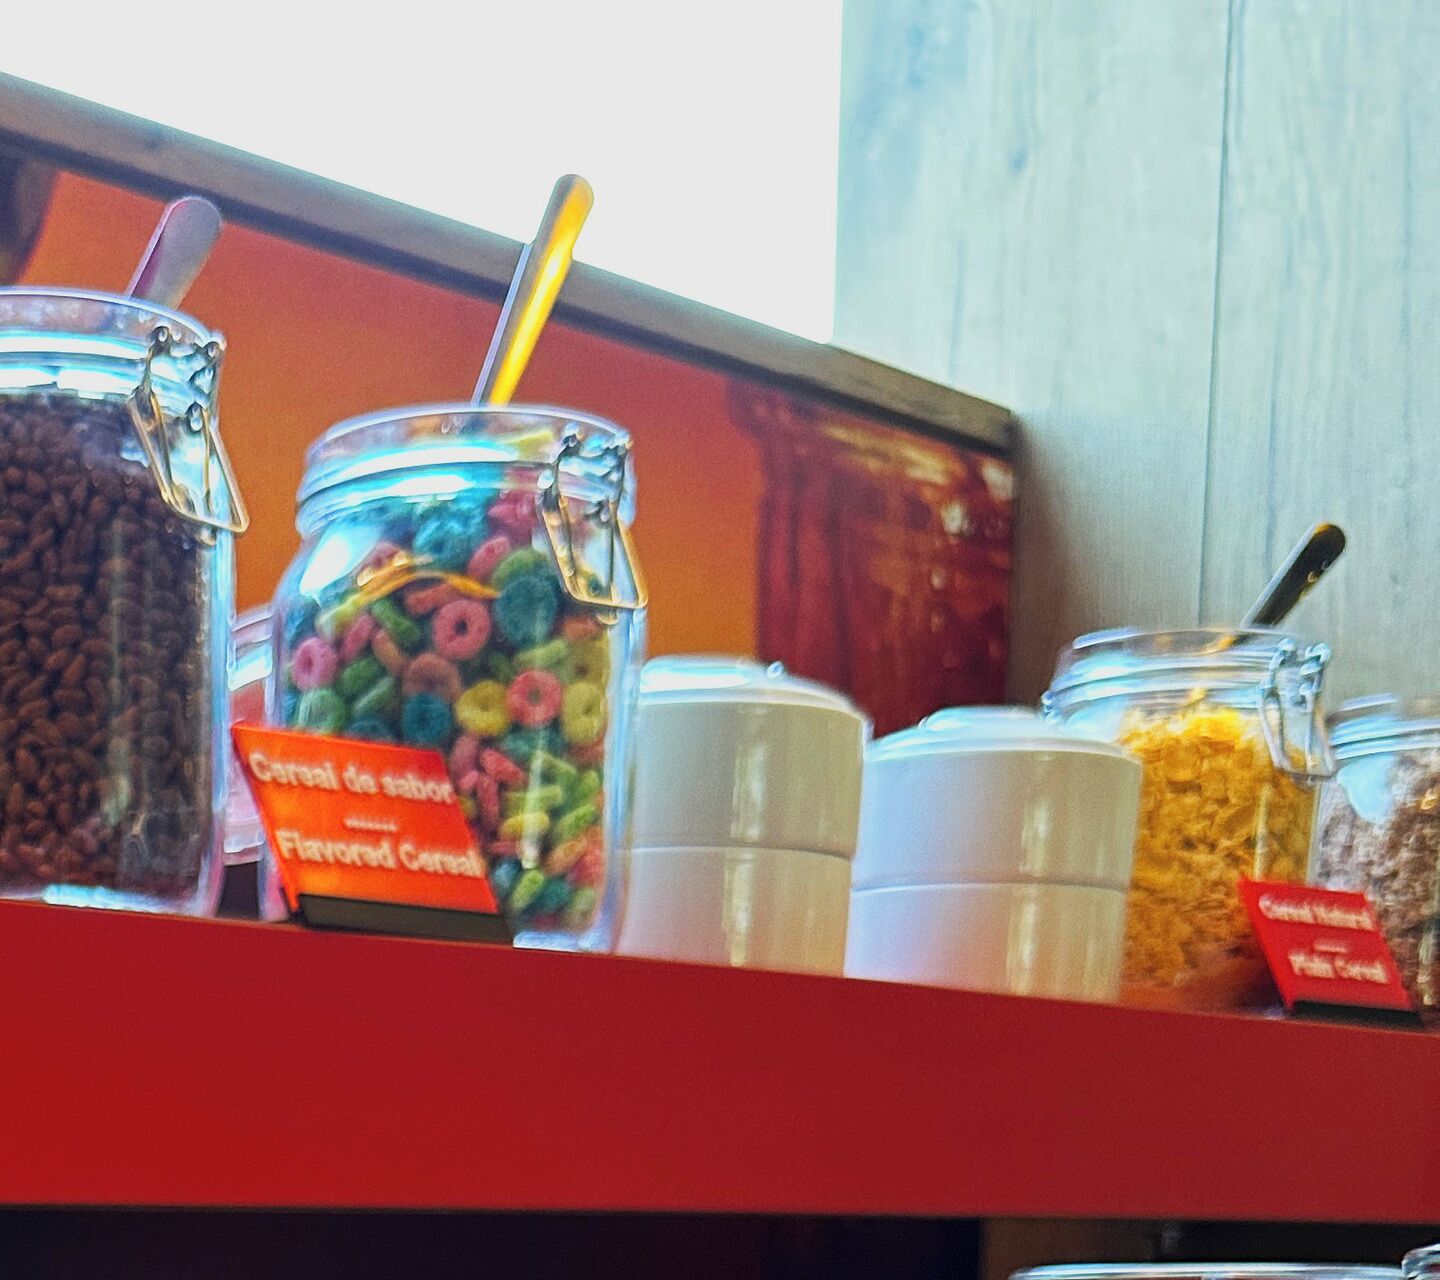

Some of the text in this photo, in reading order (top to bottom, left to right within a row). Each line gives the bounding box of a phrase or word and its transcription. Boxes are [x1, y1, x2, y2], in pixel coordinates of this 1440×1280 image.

[250, 751, 454, 805] Cereal de sabor
[275, 828, 484, 878] Flavored Cereal
